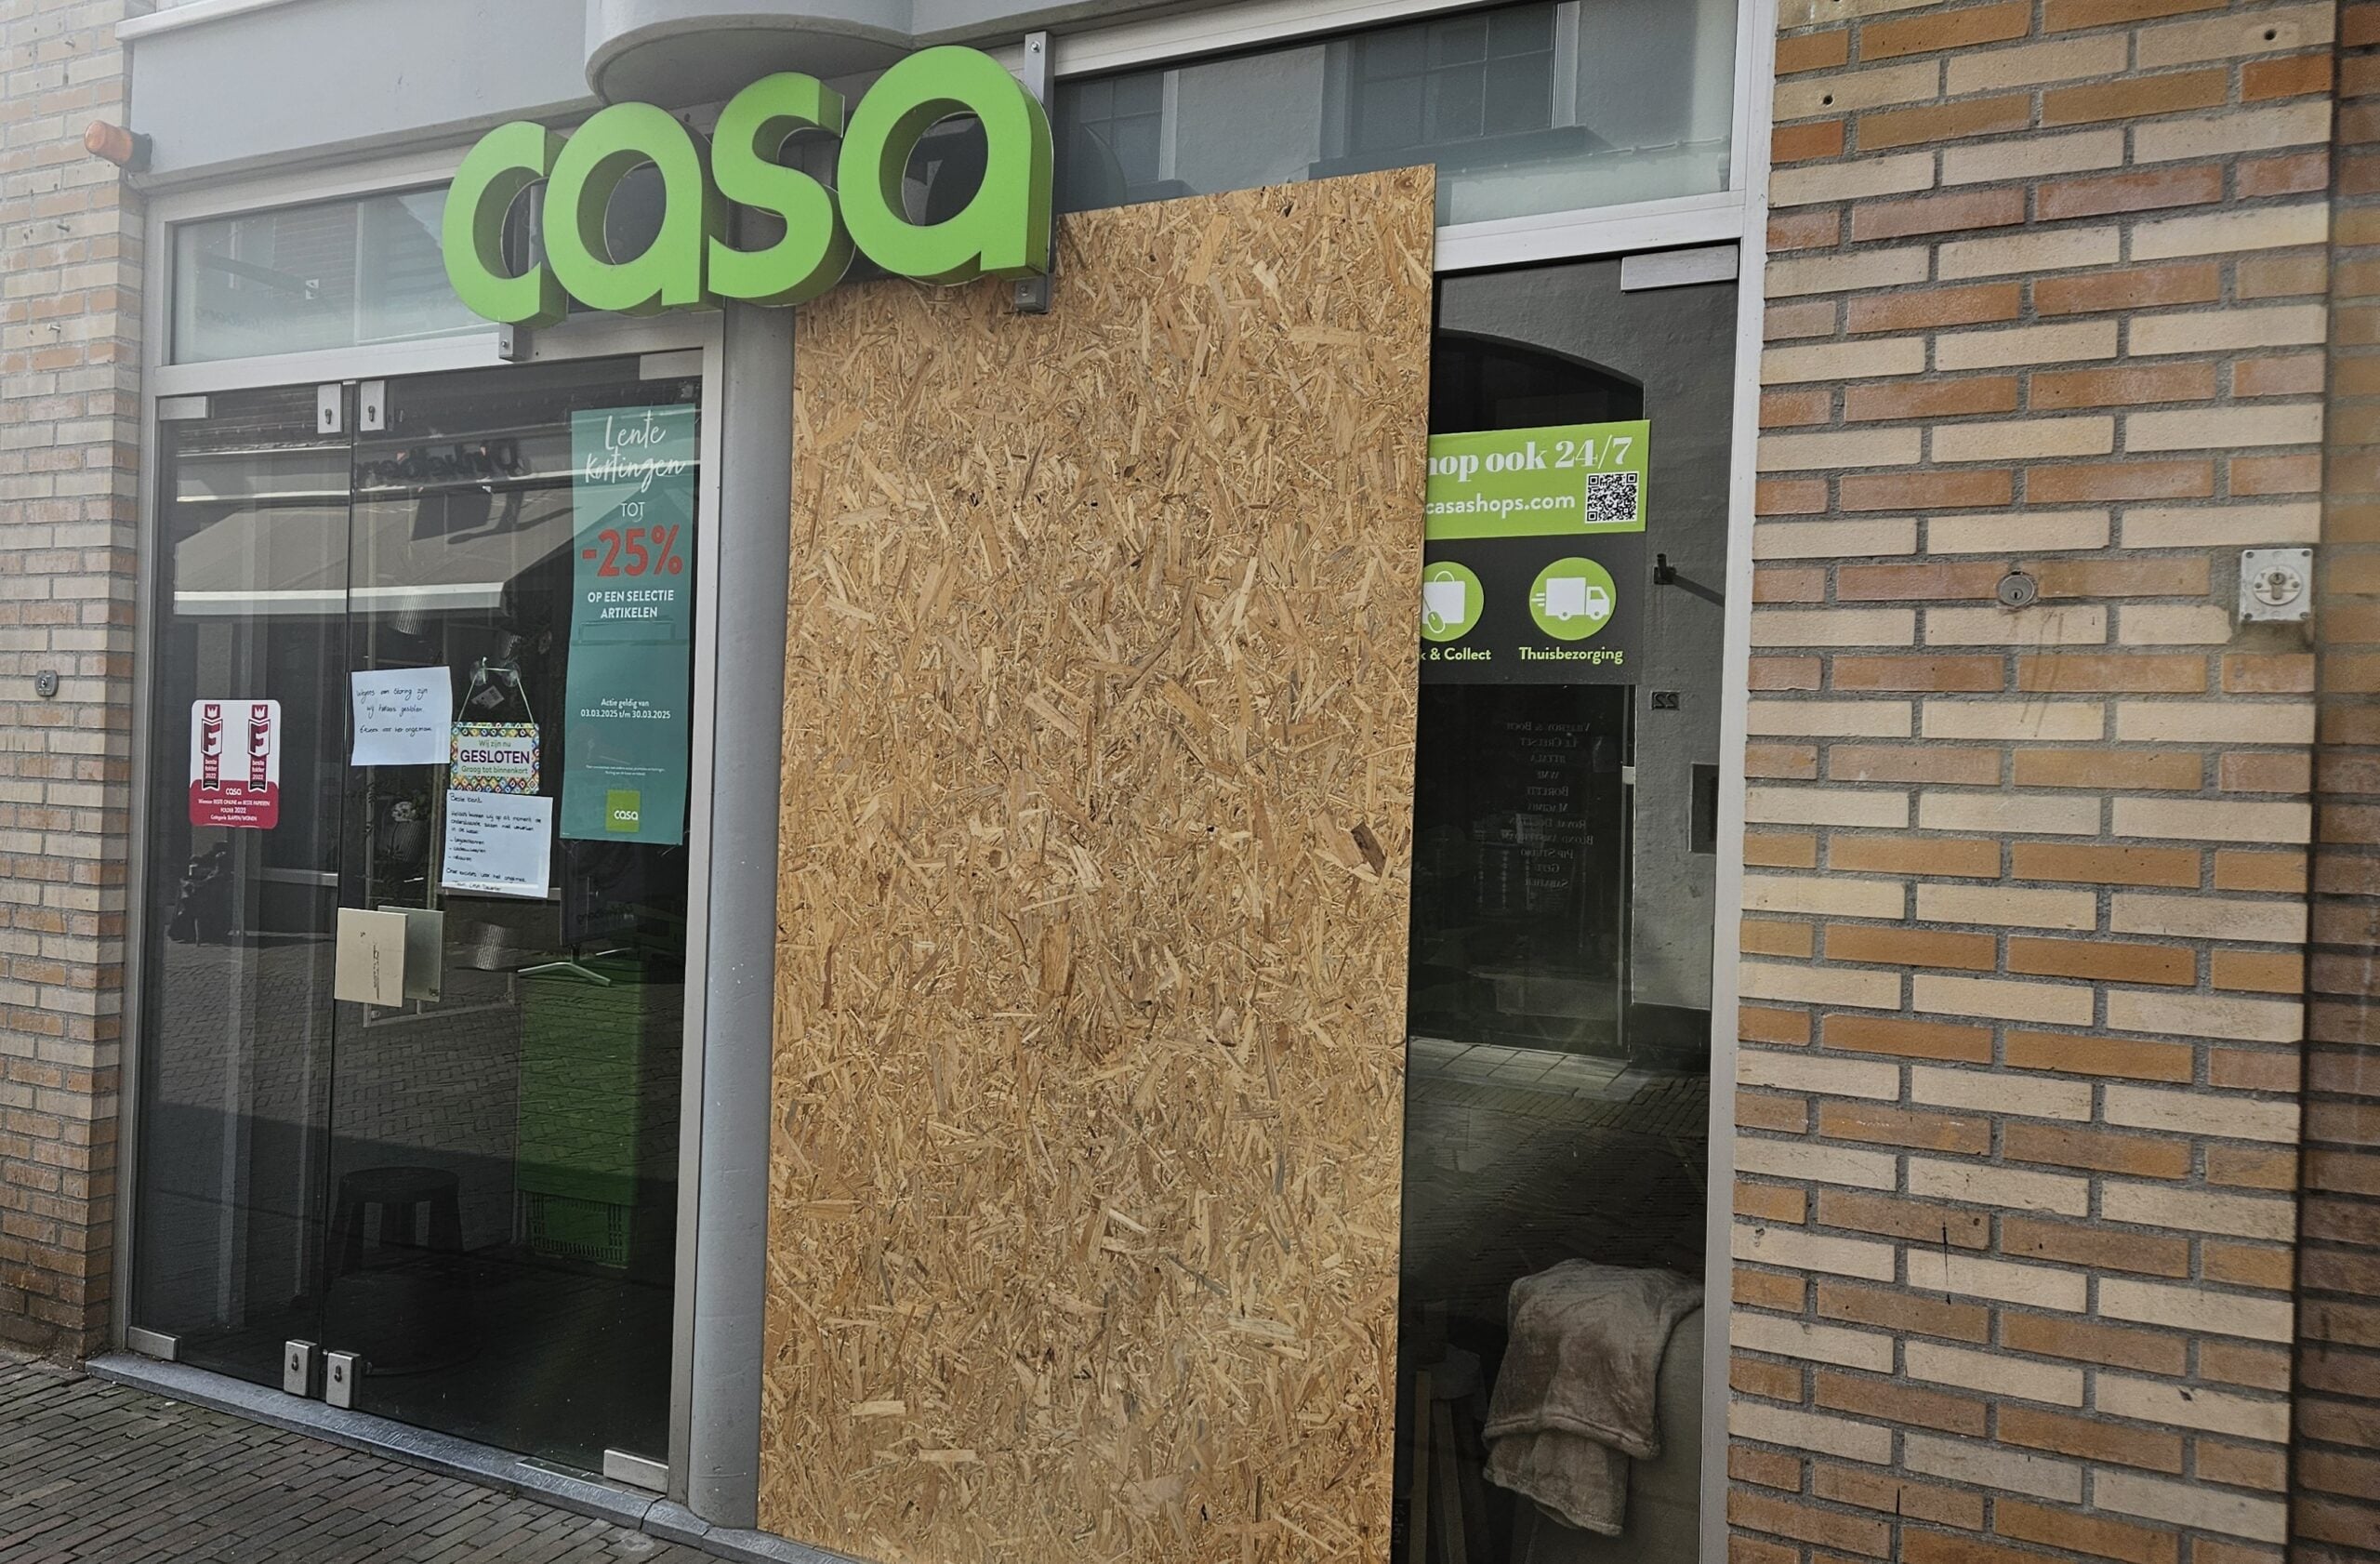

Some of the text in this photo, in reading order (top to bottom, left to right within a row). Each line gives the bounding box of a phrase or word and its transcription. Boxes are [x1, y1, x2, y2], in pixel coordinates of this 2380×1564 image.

[442, 45, 1043, 325] casa
[604, 409, 667, 450] Lente
[1486, 441, 1547, 472] ook
[1554, 434, 1633, 470] 24/7
[585, 445, 686, 493] Kortingen
[619, 502, 645, 522] TOT
[1425, 493, 1576, 520] casashops.com
[582, 524, 683, 577] -25%
[588, 590, 675, 603] OP EEN SELECTIE
[601, 606, 658, 618] ARTIKELEN
[1429, 648, 1441, 661] &
[1444, 647, 1492, 661] Collect
[1518, 646, 1624, 665] Thuisbezorging
[601, 698, 617, 707] Actie
[618, 698, 638, 709] geldig
[580, 709, 671, 719] 03.03.2025 t/m 30.03.2025
[460, 749, 530, 764] GESLOTEN
[461, 765, 481, 774] Graag
[493, 766, 528, 775] binnenkort
[225, 788, 243, 796] casa
[614, 810, 639, 821] casa
